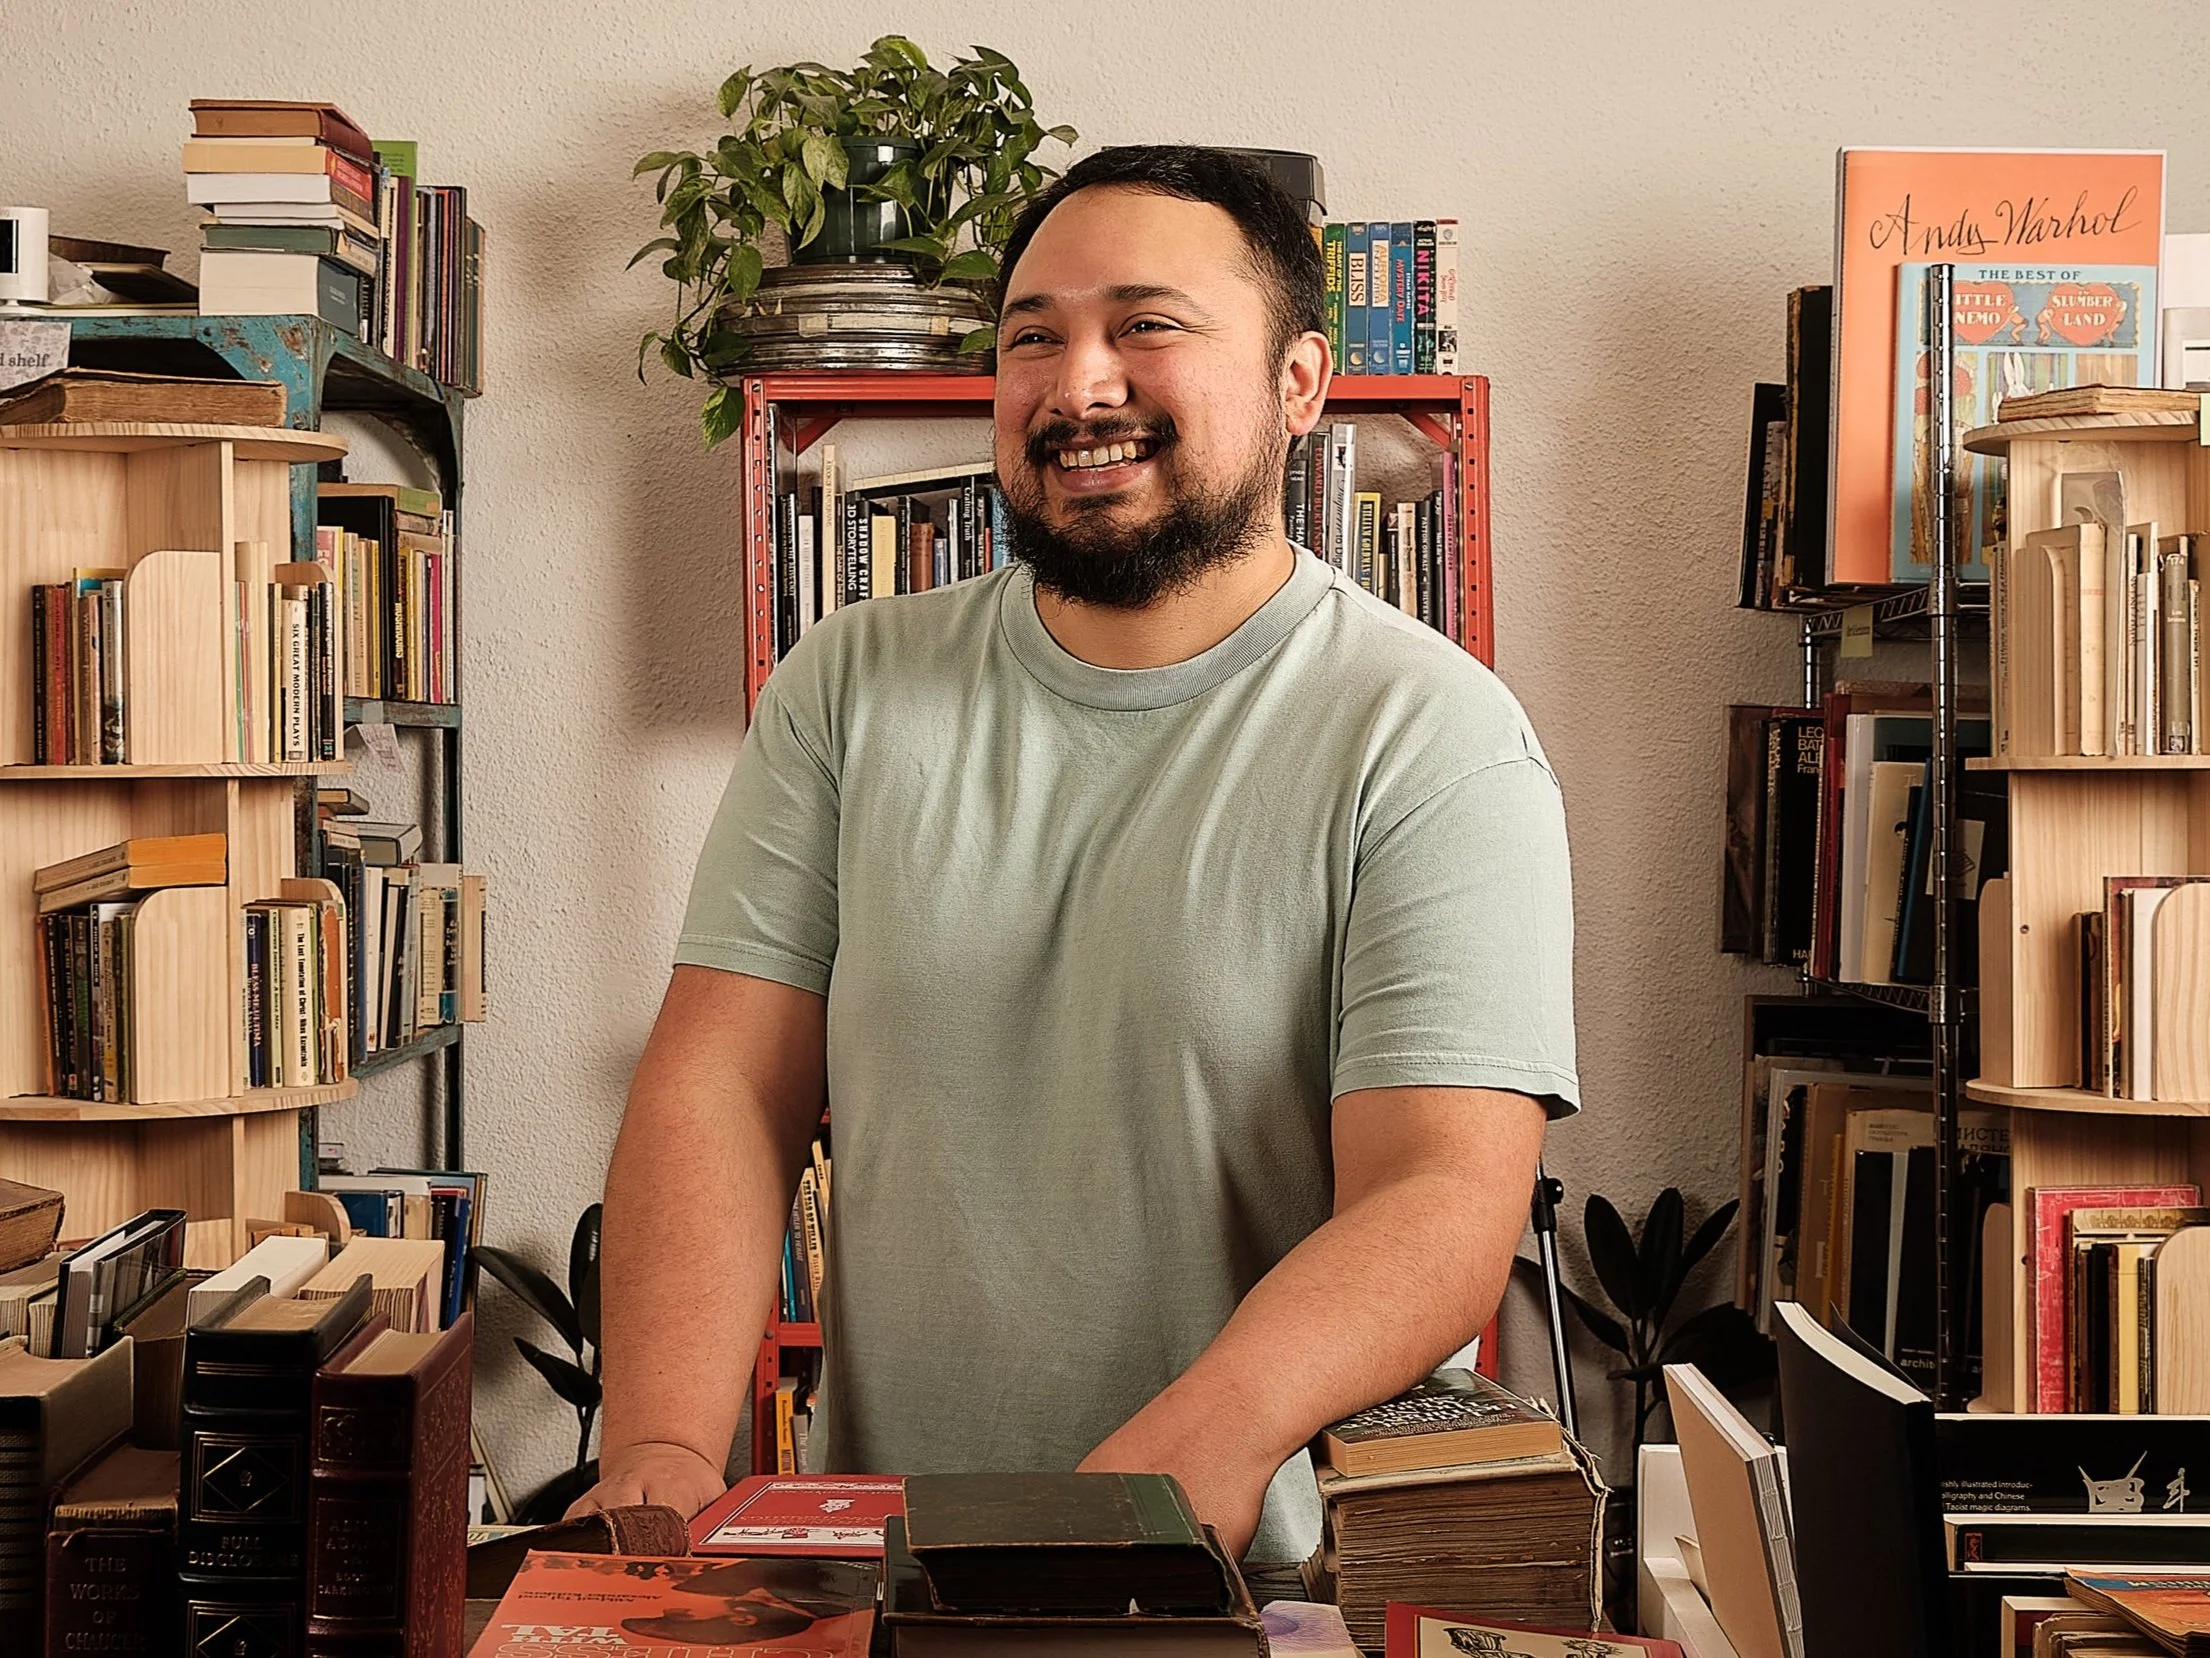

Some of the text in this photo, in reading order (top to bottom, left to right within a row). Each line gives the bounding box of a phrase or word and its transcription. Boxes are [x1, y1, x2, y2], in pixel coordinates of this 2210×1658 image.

[1869, 185, 2141, 255] Andy Warhol
[1326, 241, 1337, 292] TRIFFIDS
[1379, 246, 1388, 303] AURORA
[1979, 269, 2082, 281] THE BEST OF
[1351, 257, 1365, 302] BLISS
[1417, 250, 1430, 316] NIKITA
[1396, 259, 1406, 323] MYSTERY DATE
[1954, 293, 2007, 308] ITTLE
[2052, 294, 2113, 309] SLUMBER
[1953, 311, 2001, 326] NEMO
[2063, 312, 2106, 327] LAND
[8, 352, 50, 368] shelf
[1313, 447, 1323, 495] EDWARD
[962, 486, 973, 541] Crafting Truth
[1296, 503, 1305, 524] THE
[1361, 503, 1373, 537] WILLIAM
[1421, 517, 1430, 543] PATTON
[847, 504, 857, 591] 3D STORYTELLING
[1335, 535, 1343, 544] to
[858, 518, 869, 600] SHADOW CRAF
[1421, 545, 1430, 572] OSWALT
[1422, 590, 1430, 615] SILVER
[292, 623, 301, 747] SIX GREAT MODERN PLAYS
[1797, 764, 1819, 775] Fran
[297, 932, 306, 943] The
[252, 963, 262, 992] BLESS
[298, 997, 308, 1015] Christ
[254, 1010, 263, 1046] ULTIMA
[803, 1179, 812, 1196] THE
[807, 1213, 815, 1223] OF
[808, 1224, 817, 1251] WILLIE
[1978, 1491, 1993, 1500] and
[1994, 1491, 2025, 1501] Chinese
[1969, 1504, 1994, 1512] magic
[222, 1535, 262, 1550] FULL
[84, 1556, 128, 1573] THE
[187, 1550, 299, 1568] DISCLOSURE
[69, 1583, 141, 1601] WORKS
[91, 1609, 119, 1625] OF
[500, 1624, 619, 1637] TAL
[65, 1631, 148, 1651] CHAUCER
[509, 1635, 629, 1646] WITH
